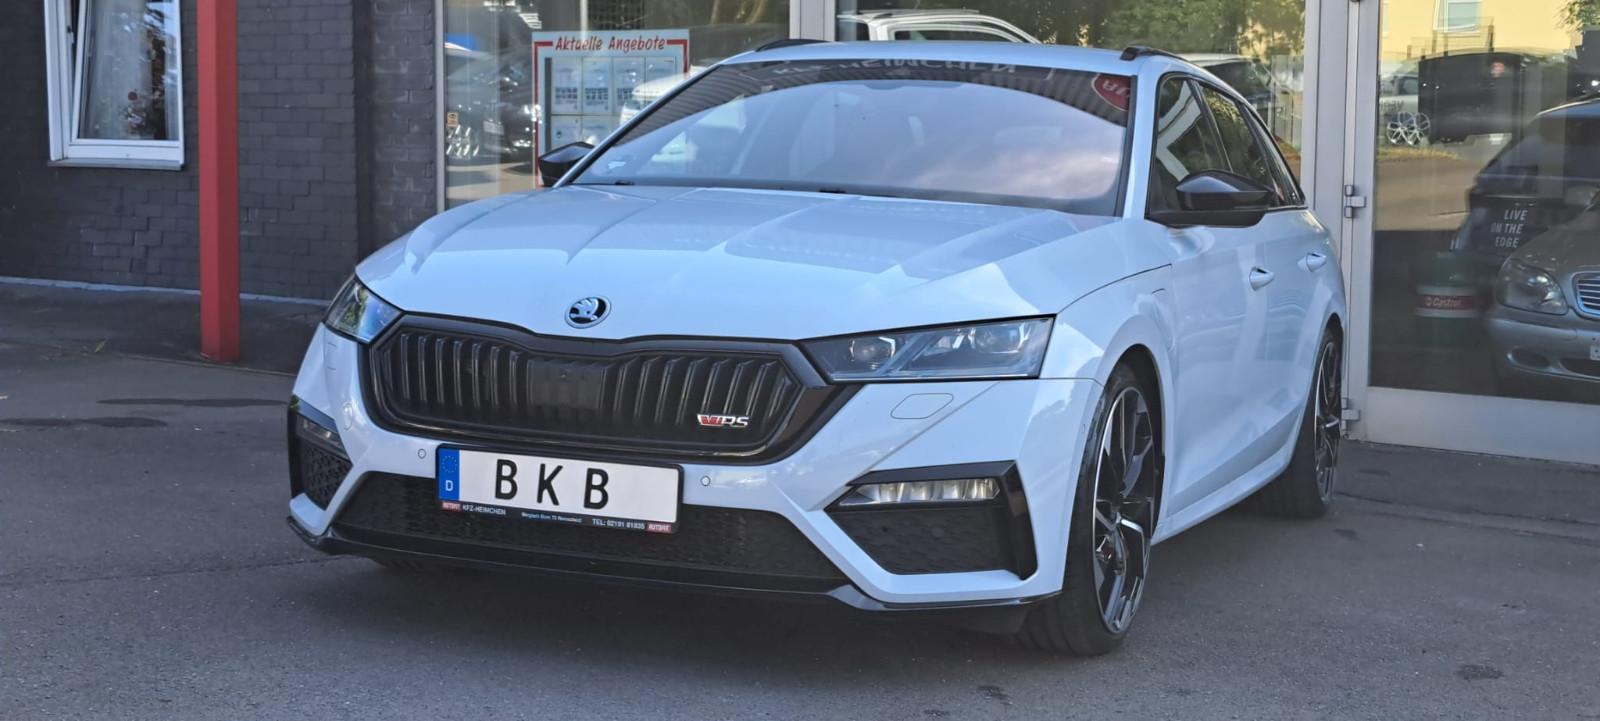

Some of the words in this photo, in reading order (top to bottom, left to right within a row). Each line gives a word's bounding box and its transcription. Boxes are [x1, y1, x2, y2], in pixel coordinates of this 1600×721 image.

[555, 36, 604, 51] Aktuelle
[608, 35, 666, 53] Angebote
[1503, 209, 1528, 221] LIVE
[1504, 223, 1525, 234] THE
[1495, 236, 1520, 249] EDGE
[445, 479, 454, 492] D
